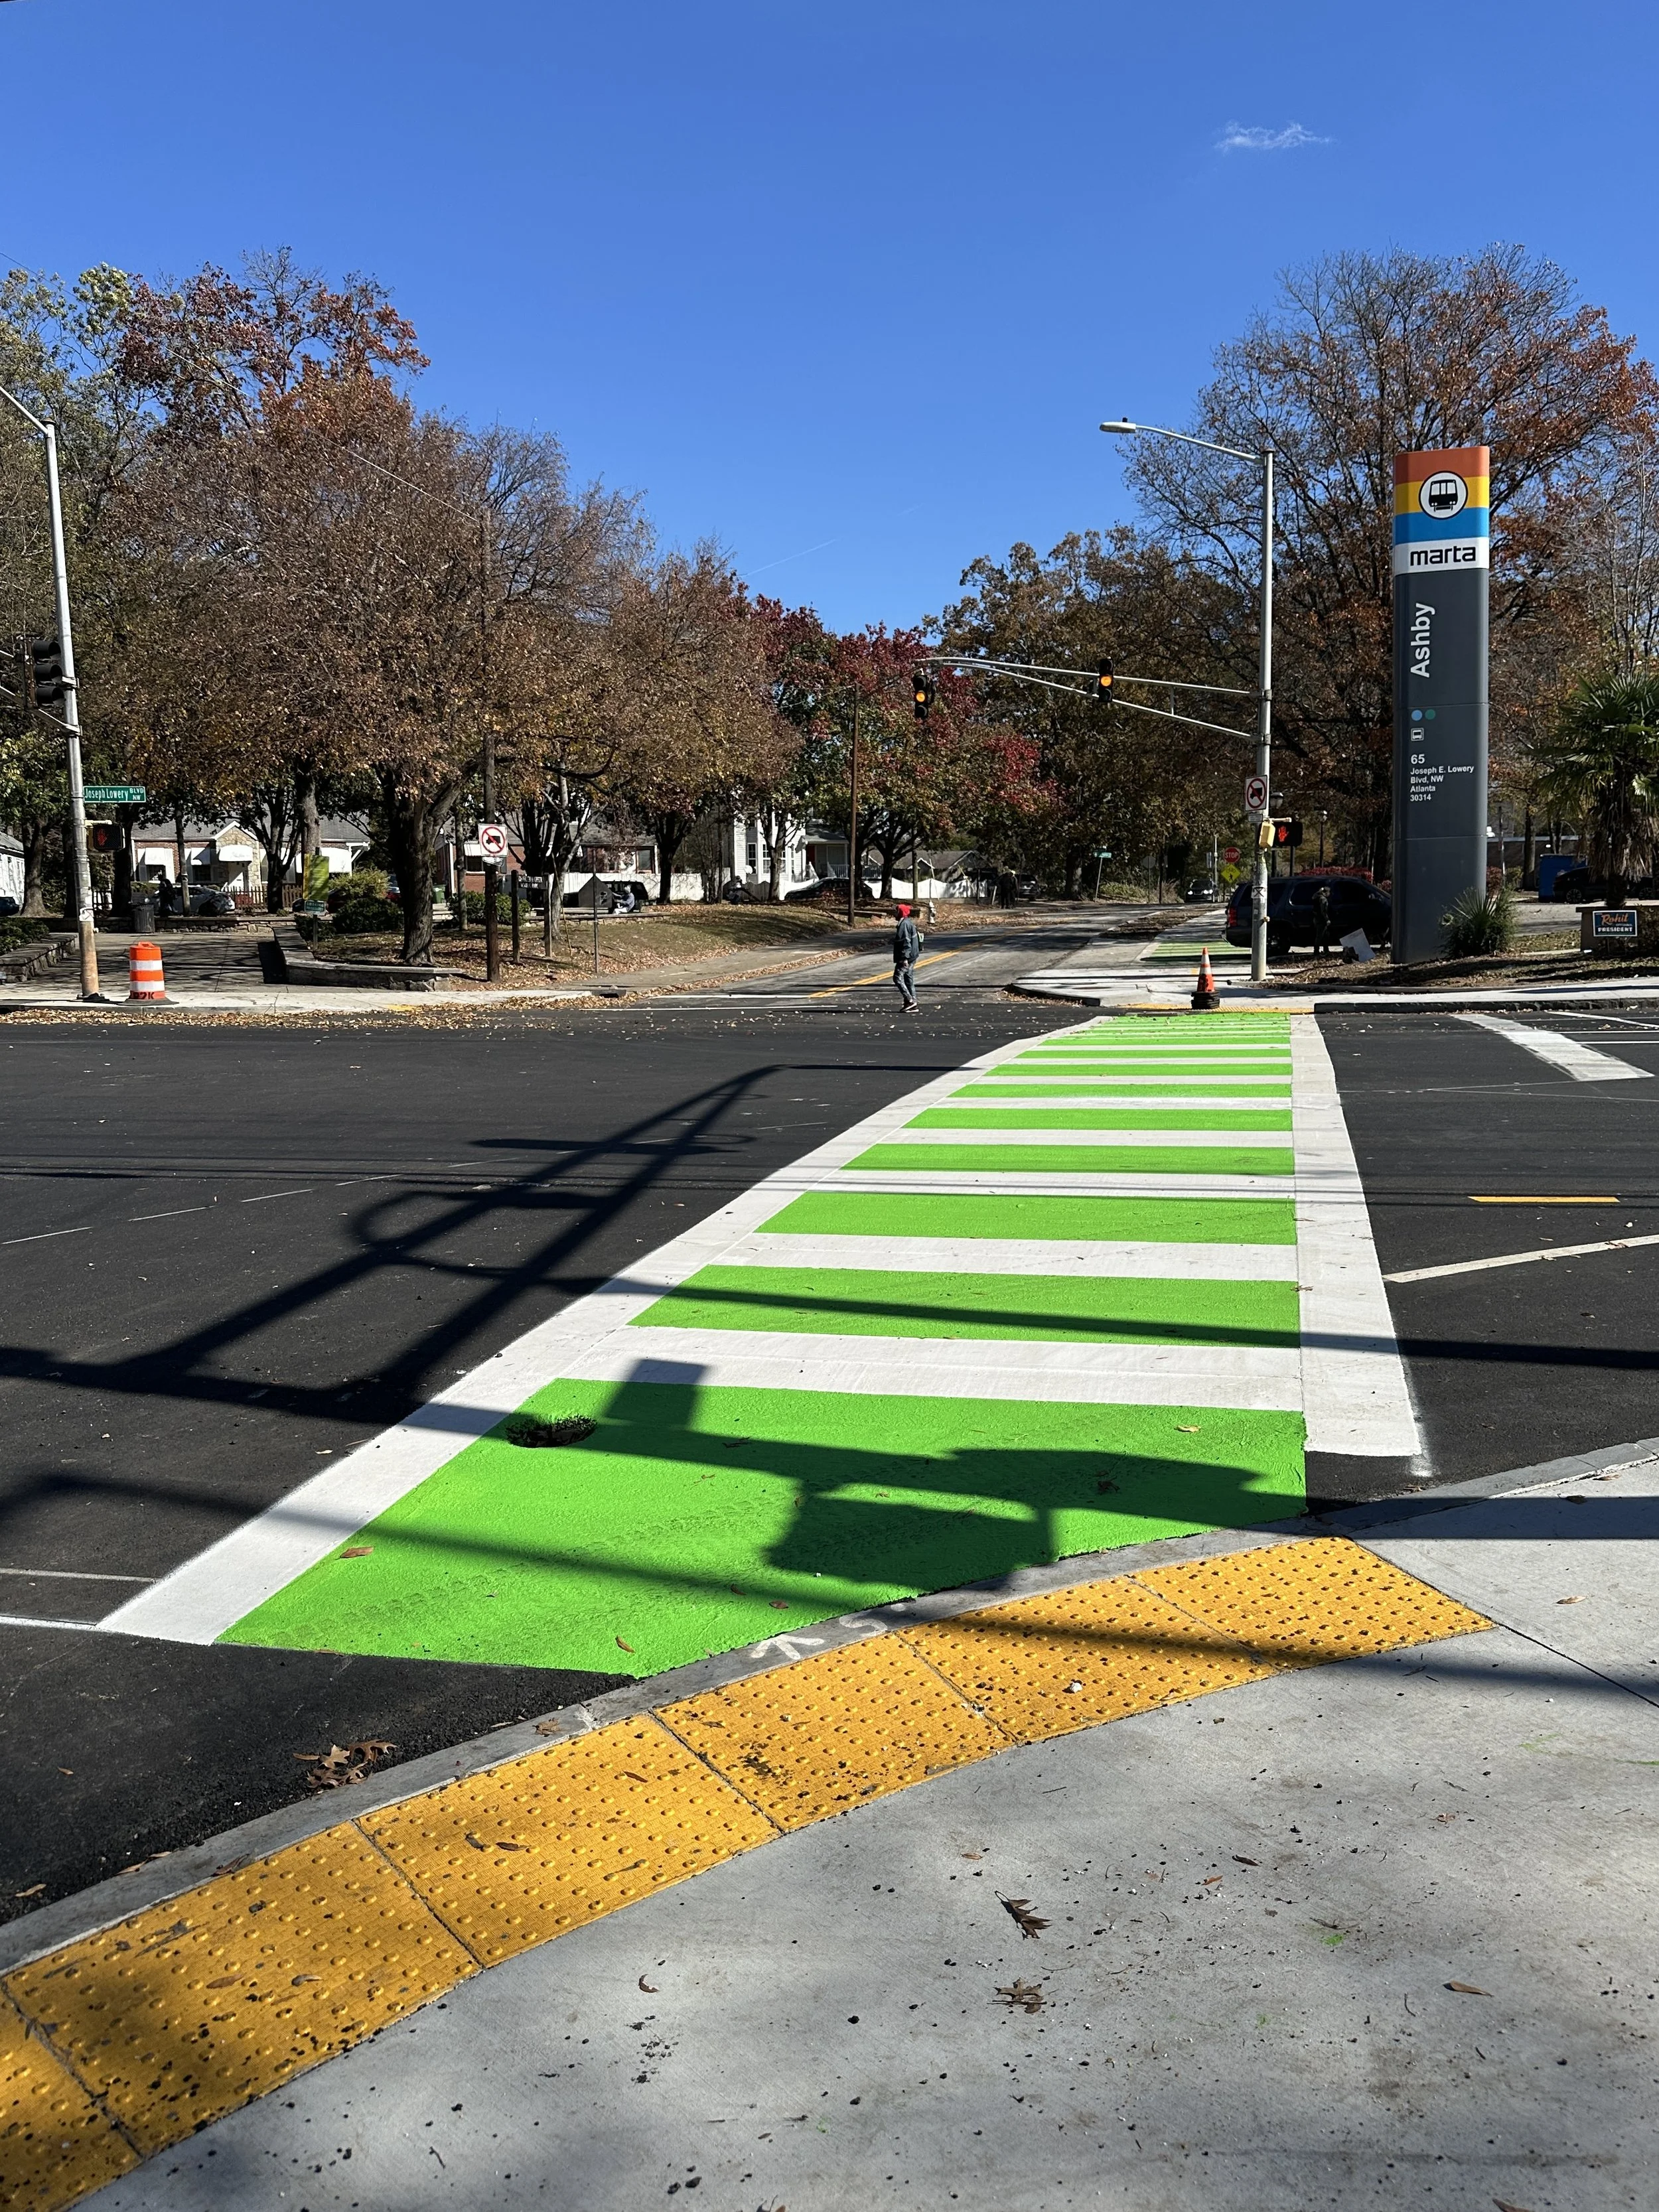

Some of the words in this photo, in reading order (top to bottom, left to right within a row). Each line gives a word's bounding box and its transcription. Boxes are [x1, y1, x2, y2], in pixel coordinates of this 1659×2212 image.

[1410, 546, 1476, 566] marta
[1410, 602, 1435, 678] Ashby
[1410, 754, 1425, 764] 65
[85, 788, 106, 801] Joseph
[106, 788, 129, 801] Lowery
[1601, 913, 1628, 926] Rohit
